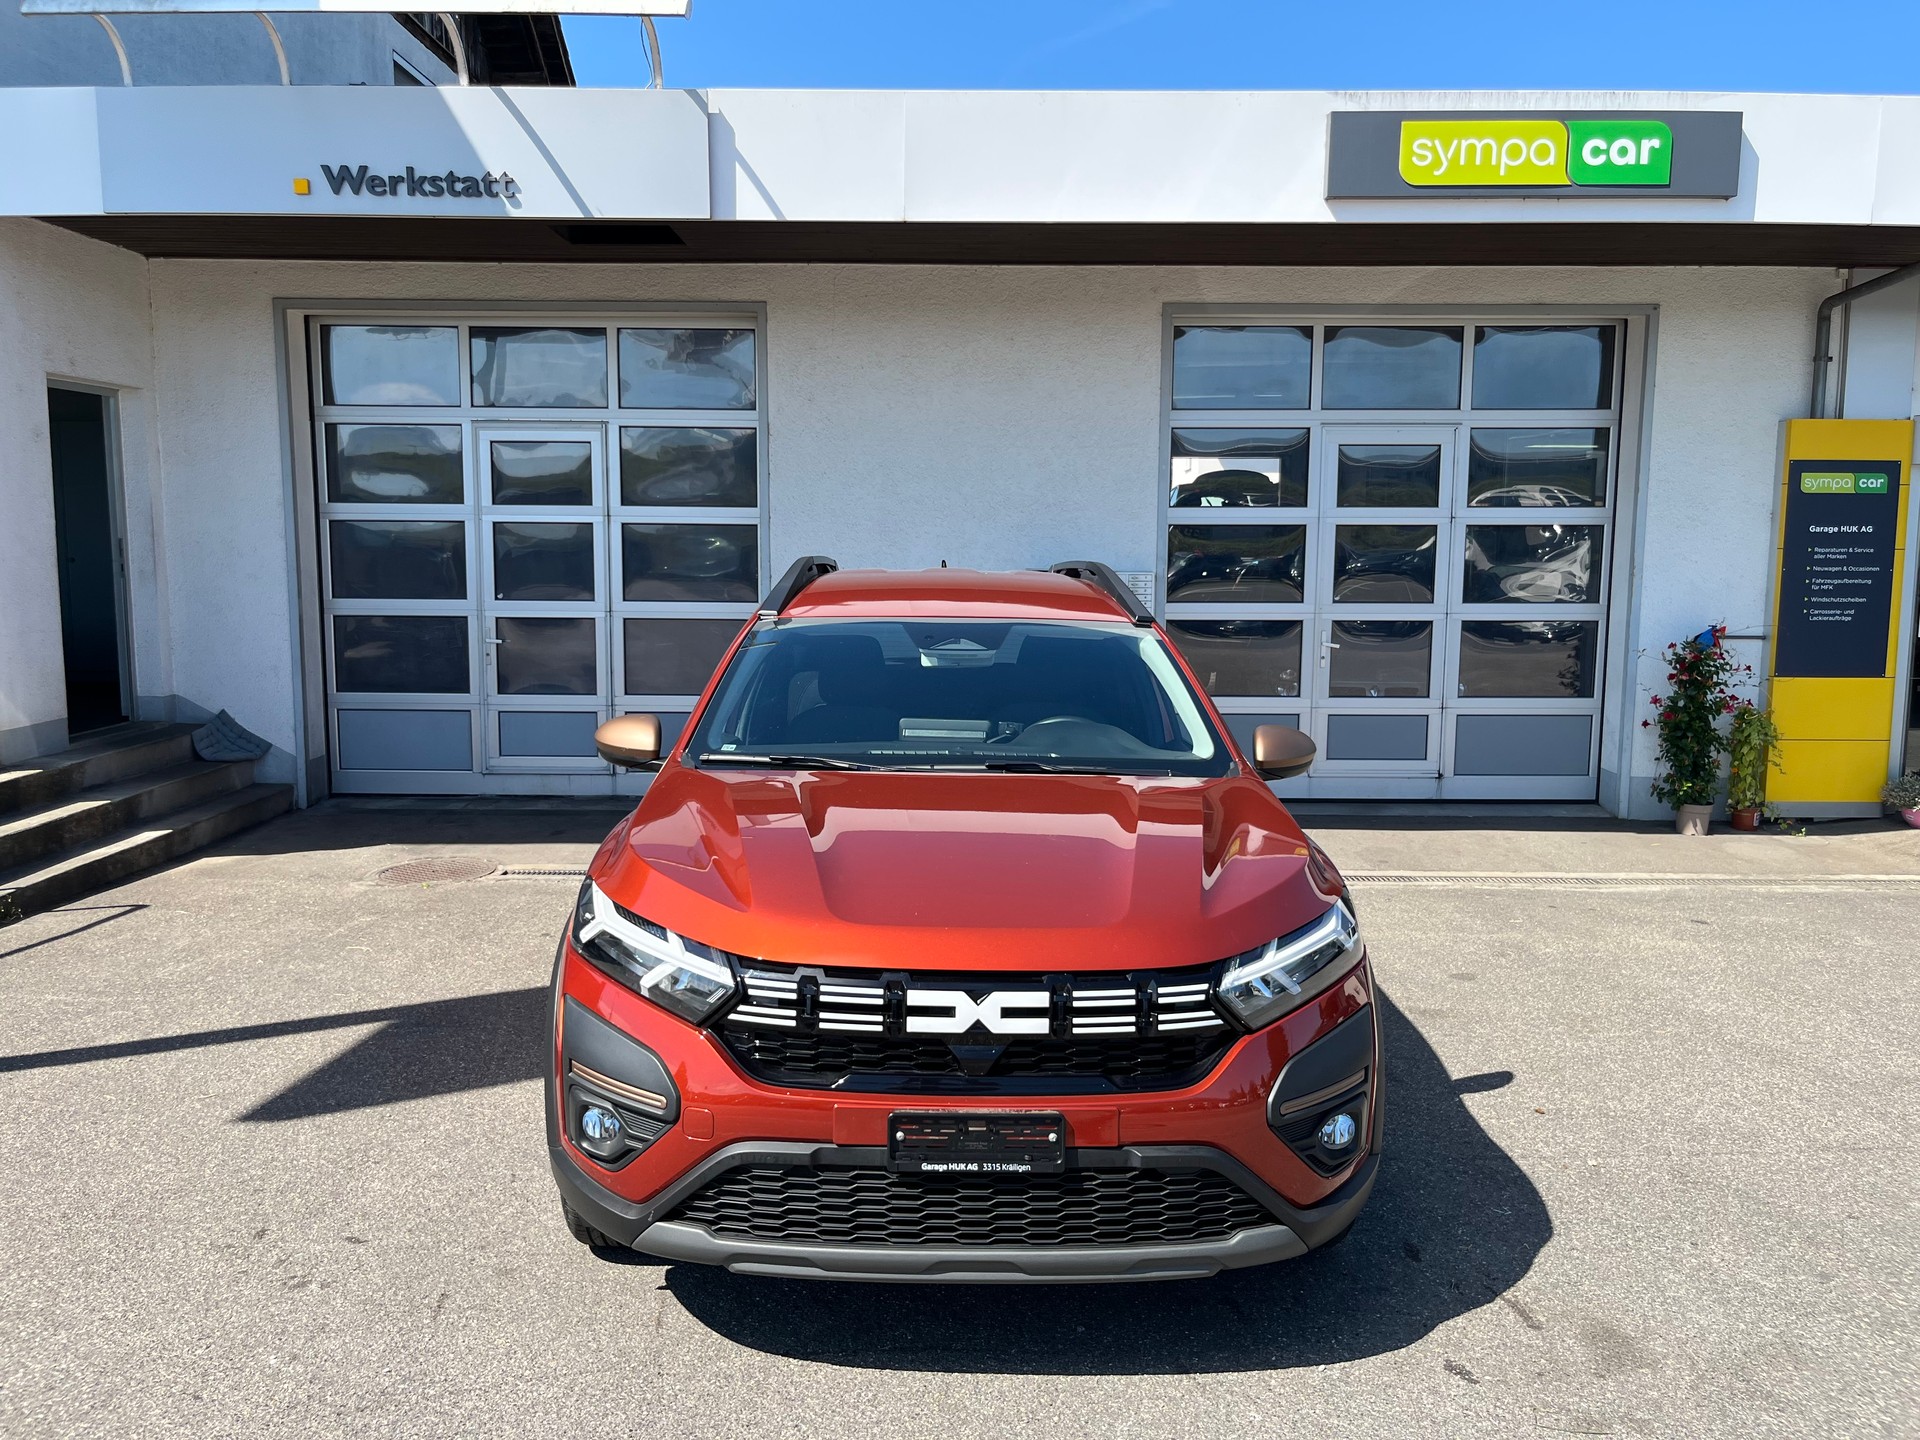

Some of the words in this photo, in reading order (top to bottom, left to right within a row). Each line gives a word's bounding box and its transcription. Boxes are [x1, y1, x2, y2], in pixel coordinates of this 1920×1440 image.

[1410, 136, 1556, 176] sympa
[1581, 136, 1661, 166] car
[320, 164, 515, 198] Werkstatt
[1804, 478, 1851, 490] sympa
[1859, 478, 1884, 488] car
[1809, 525, 1838, 534] Garage
[1840, 525, 1858, 533] HUK
[921, 1163, 948, 1172] Garage
[948, 1163, 966, 1171] HUK
[967, 1163, 979, 1171] AG
[982, 1163, 1001, 1171] 3315
